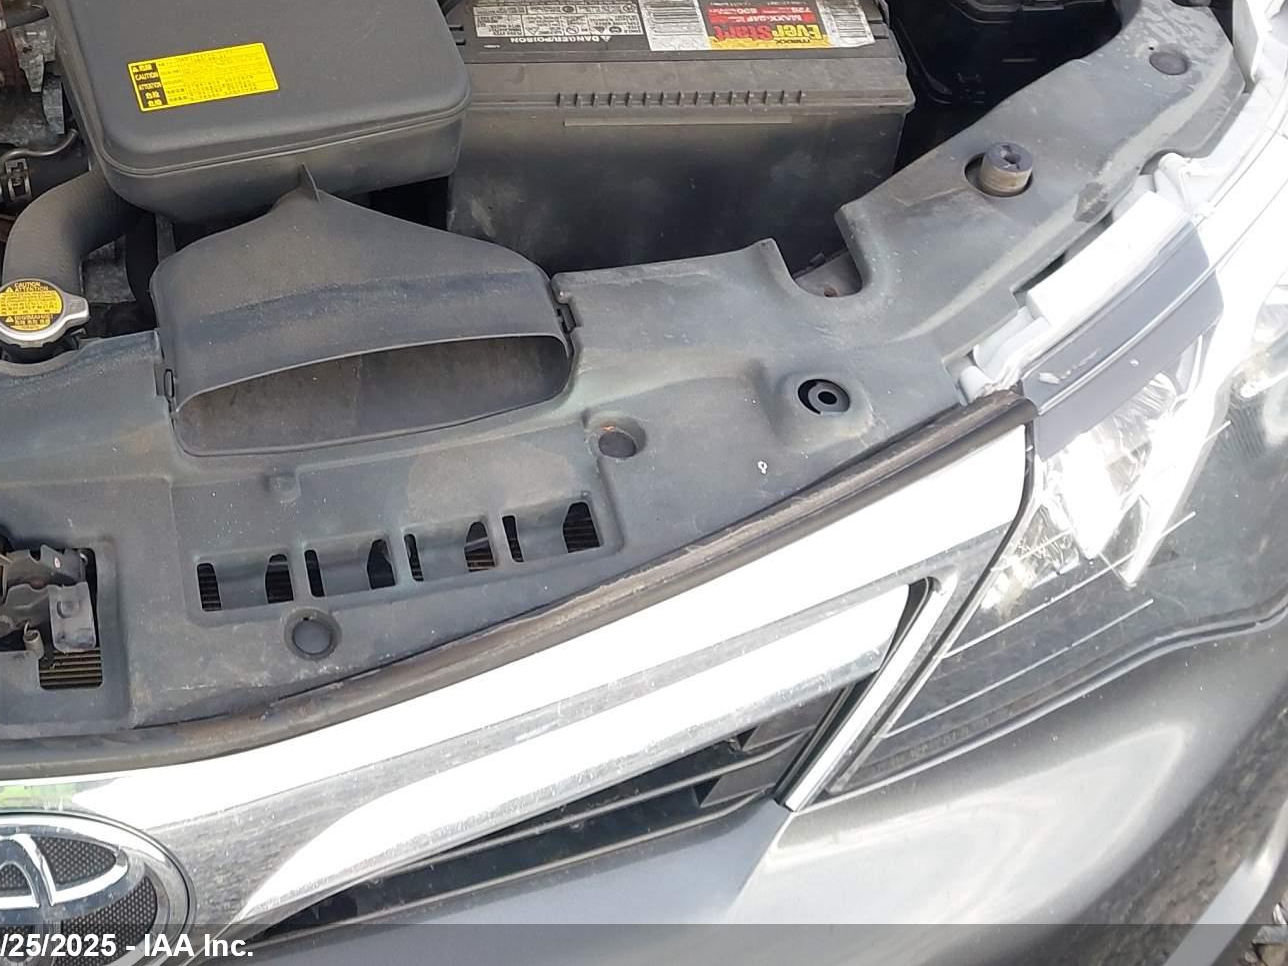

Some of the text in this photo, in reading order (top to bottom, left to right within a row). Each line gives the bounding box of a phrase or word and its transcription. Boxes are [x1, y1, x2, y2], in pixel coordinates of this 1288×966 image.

[713, 24, 823, 42] EverStart
[510, 35, 601, 43] DANGER/POISON
[134, 71, 159, 81] CAUTION
[14, 285, 50, 293] ATTENTION
